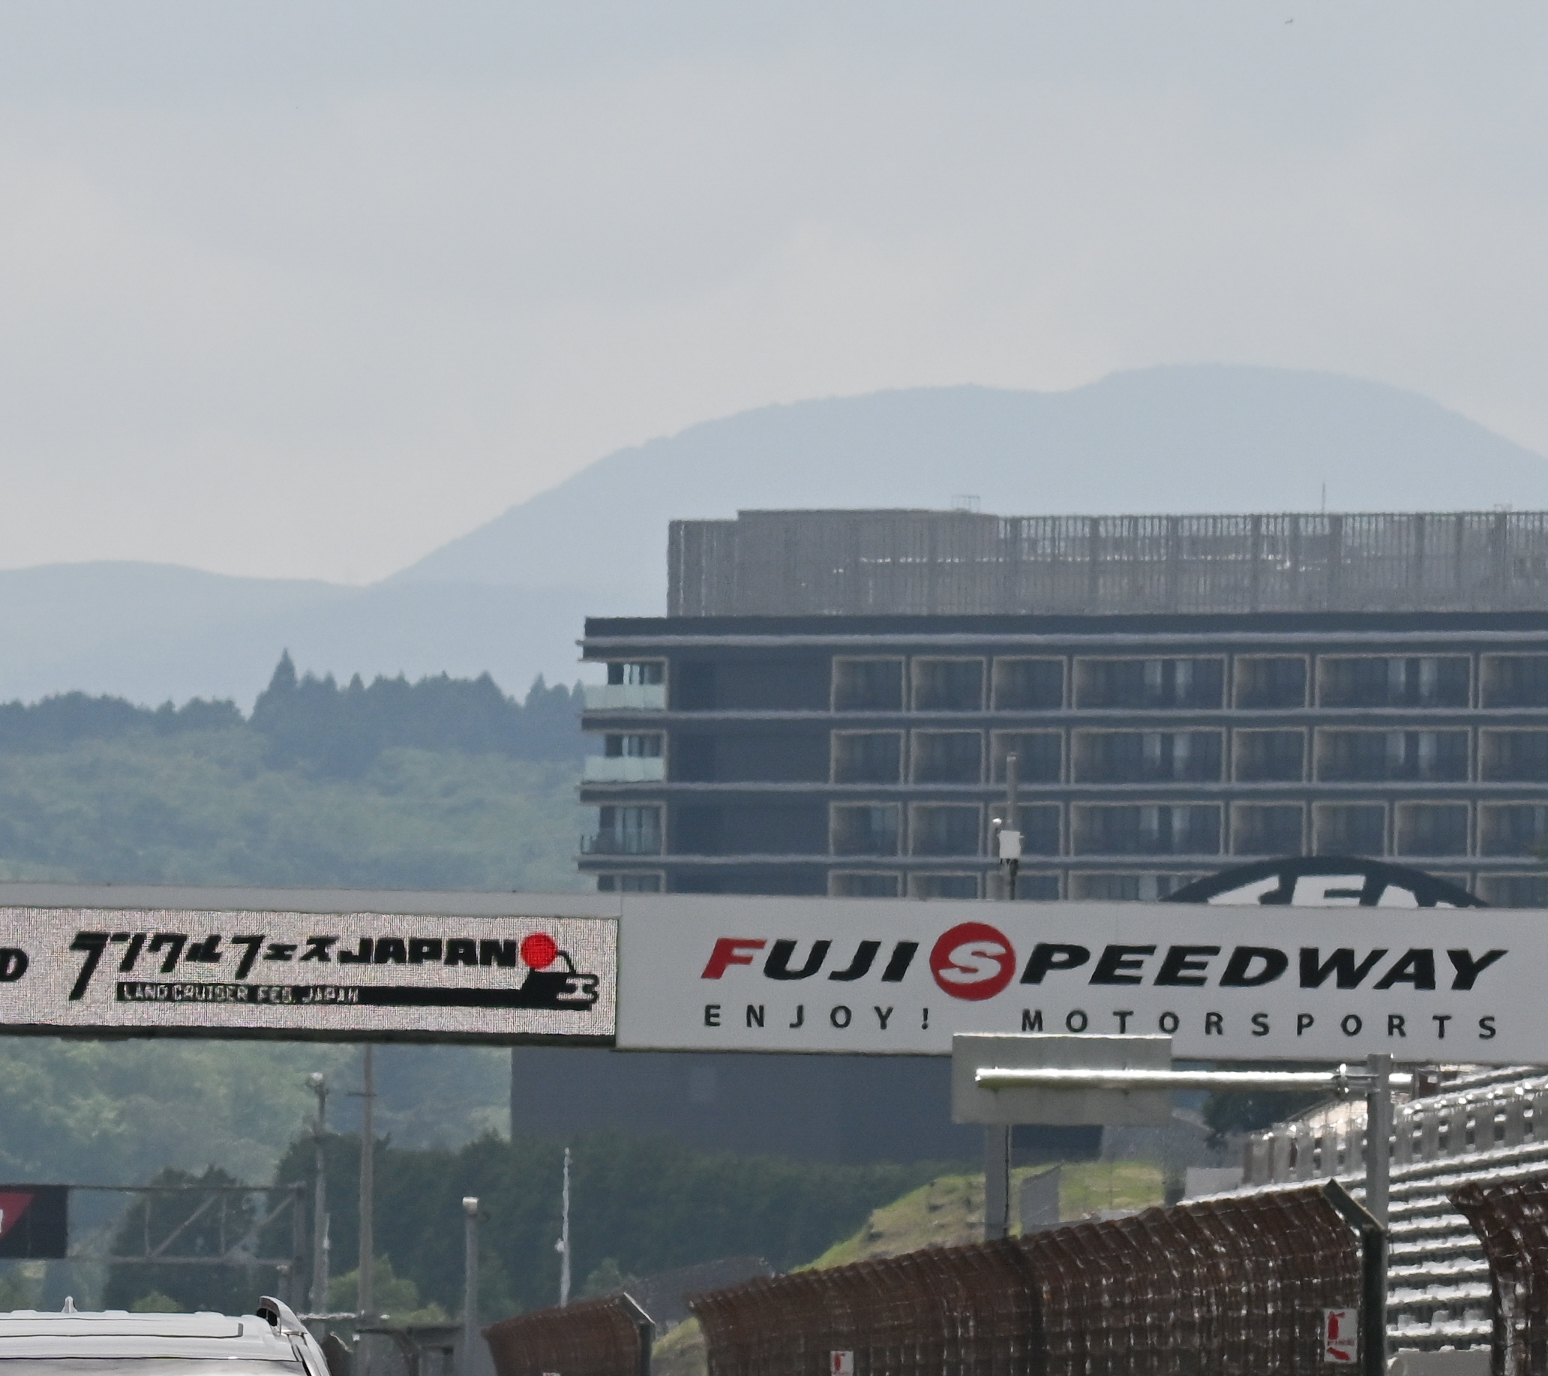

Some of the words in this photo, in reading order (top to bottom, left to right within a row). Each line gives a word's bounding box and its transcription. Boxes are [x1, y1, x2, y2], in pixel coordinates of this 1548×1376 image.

[701, 937, 919, 983] FUJI
[938, 938, 1507, 991] SPEEDWAY
[704, 1004, 931, 1031] ENJOY!
[1021, 1008, 1498, 1040] MOTORSPORTS
